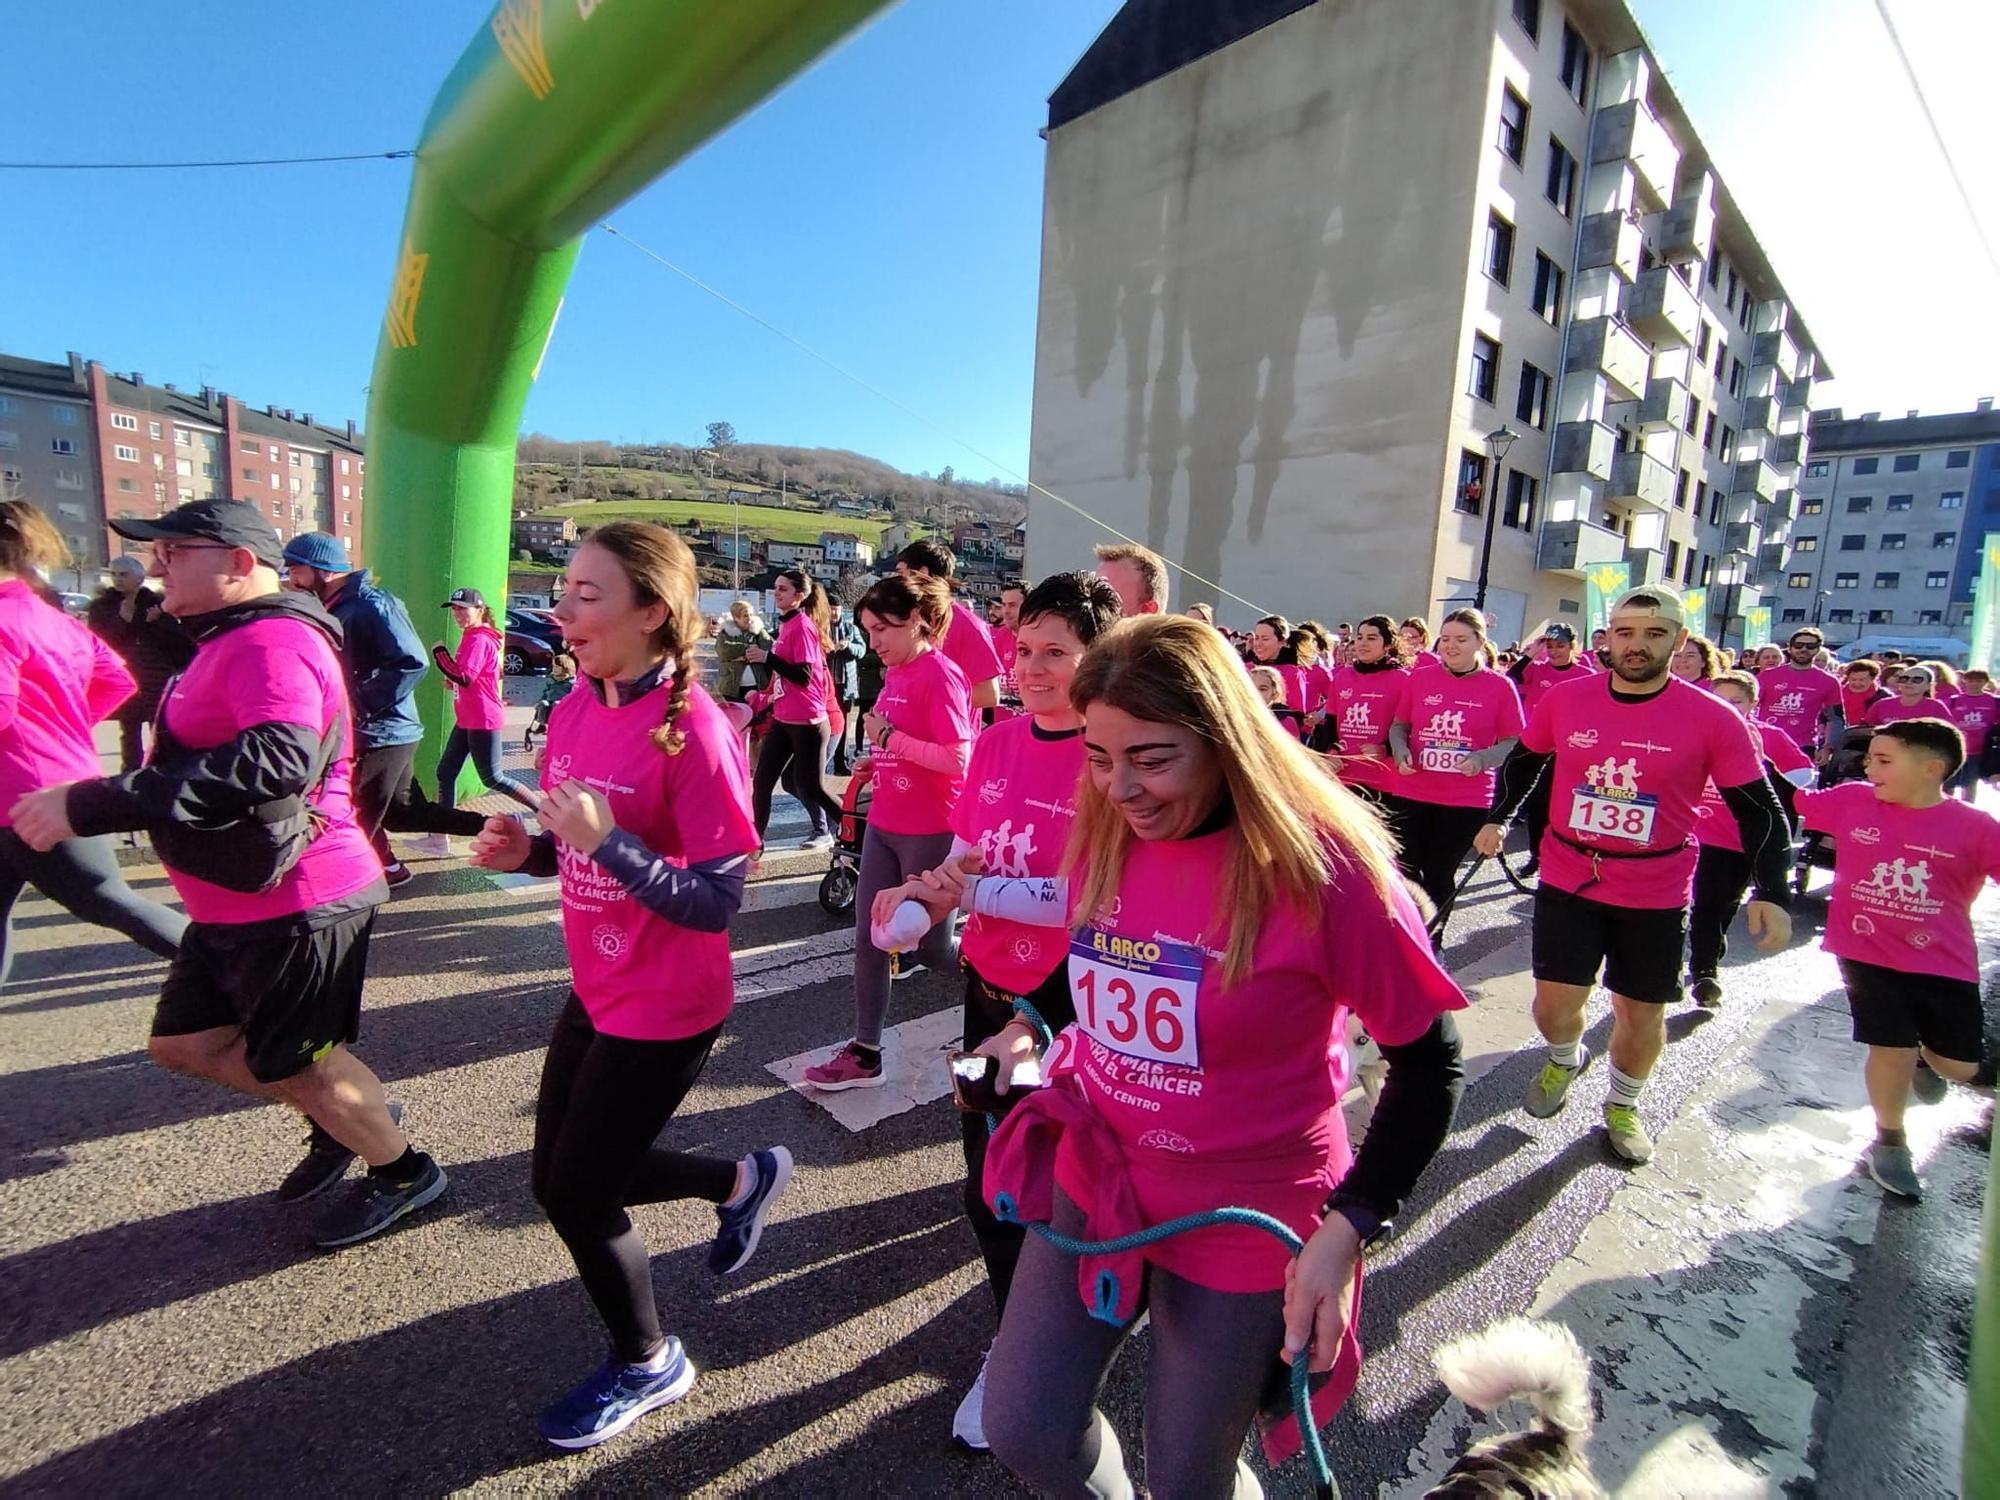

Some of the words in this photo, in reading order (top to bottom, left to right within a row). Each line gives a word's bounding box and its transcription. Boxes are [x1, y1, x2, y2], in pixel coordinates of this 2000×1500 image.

[1607, 788, 1638, 800] ARCO
[1578, 800, 1646, 835] 138
[1092, 931, 1109, 952] EL
[1110, 936, 1161, 963] ARCO
[1077, 968, 1184, 1053] 136
[1104, 1061, 1120, 1081] EL
[1113, 1090, 1161, 1112] CENTRO
